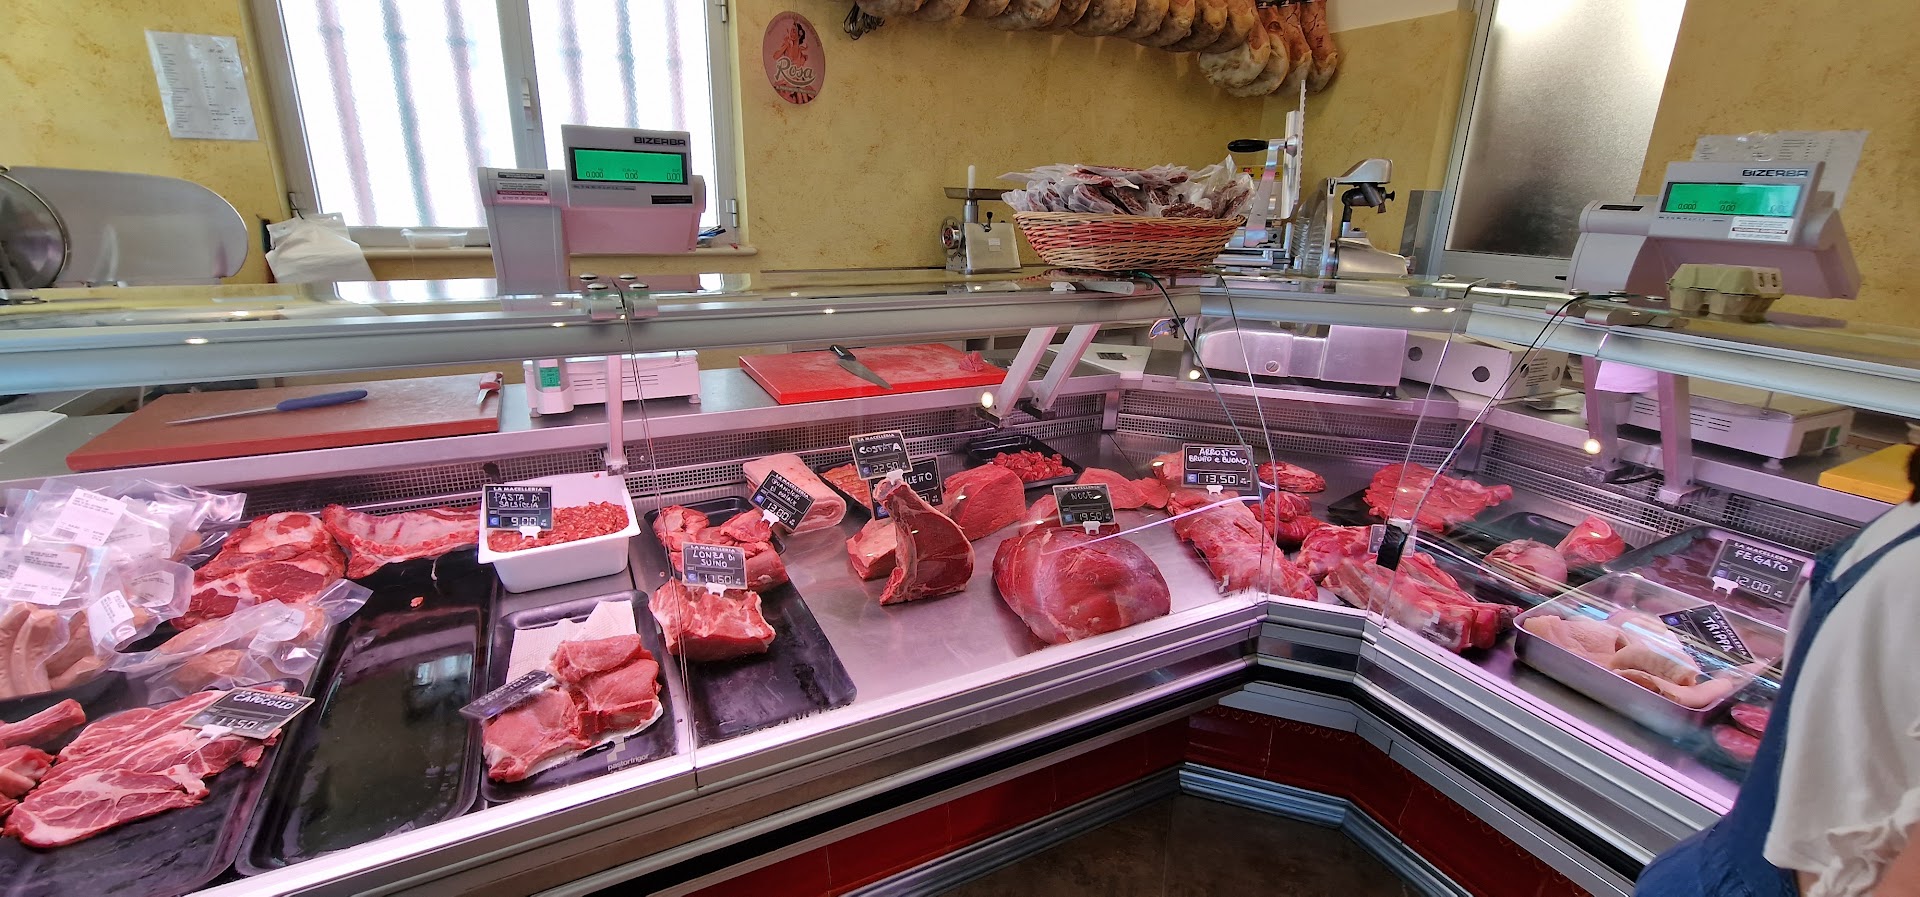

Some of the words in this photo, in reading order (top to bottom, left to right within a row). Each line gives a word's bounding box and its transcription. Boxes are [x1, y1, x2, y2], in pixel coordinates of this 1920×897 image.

[774, 57, 816, 87] Rosa
[634, 136, 686, 146] BIZERBA
[1742, 169, 1809, 177] BIZERBA
[1199, 448, 1237, 456] ARROSTO
[494, 492, 525, 502] PASTA
[699, 545, 736, 553] MACELLERIA
[692, 549, 725, 560] LONZA
[1746, 546, 1793, 564] MACELLERIA
[1734, 549, 1789, 572] FEGATO
[233, 694, 295, 710] CAPOCOLLO
